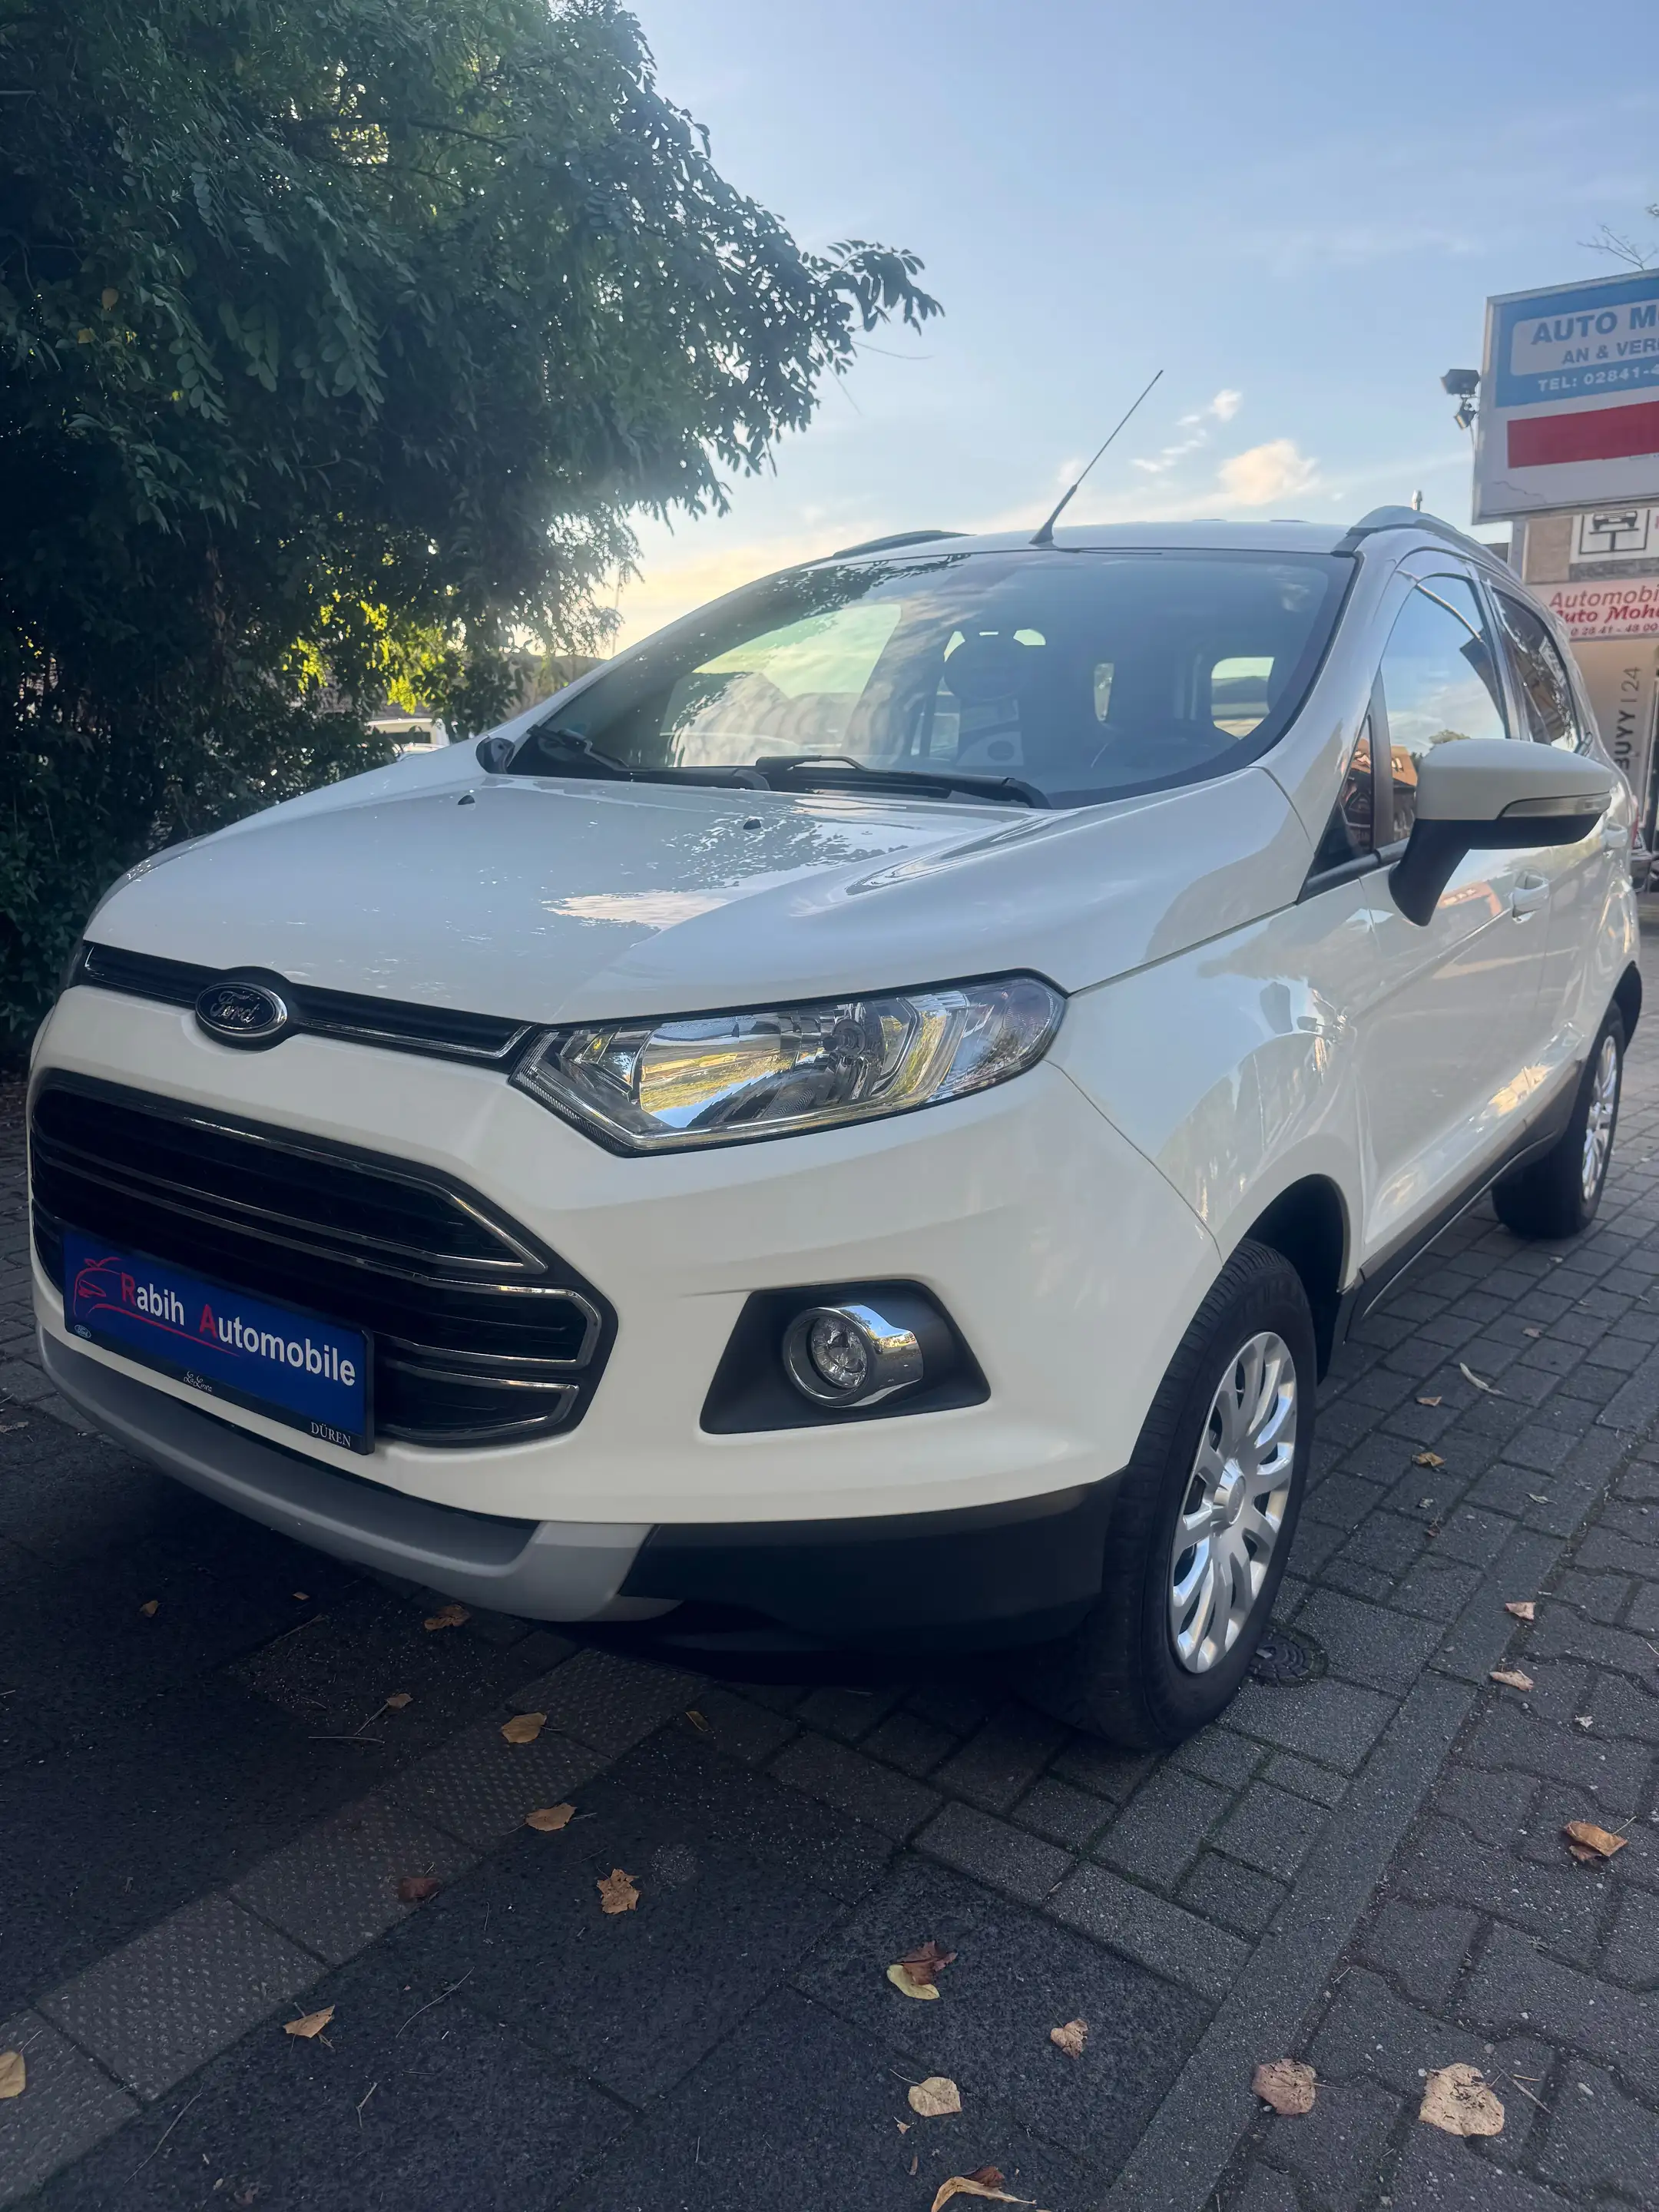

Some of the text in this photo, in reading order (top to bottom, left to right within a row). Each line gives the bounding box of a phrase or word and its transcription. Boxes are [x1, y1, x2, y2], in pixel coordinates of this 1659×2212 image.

[1531, 304, 1659, 345] AUTO M
[1561, 338, 1659, 365] AN & VER
[1538, 376, 1577, 392] TEL:
[1621, 667, 1641, 692] 24
[210, 990, 260, 1023] Ford
[121, 1271, 356, 1387] Rabih Automobile
[311, 1421, 351, 1448] DÜREN
